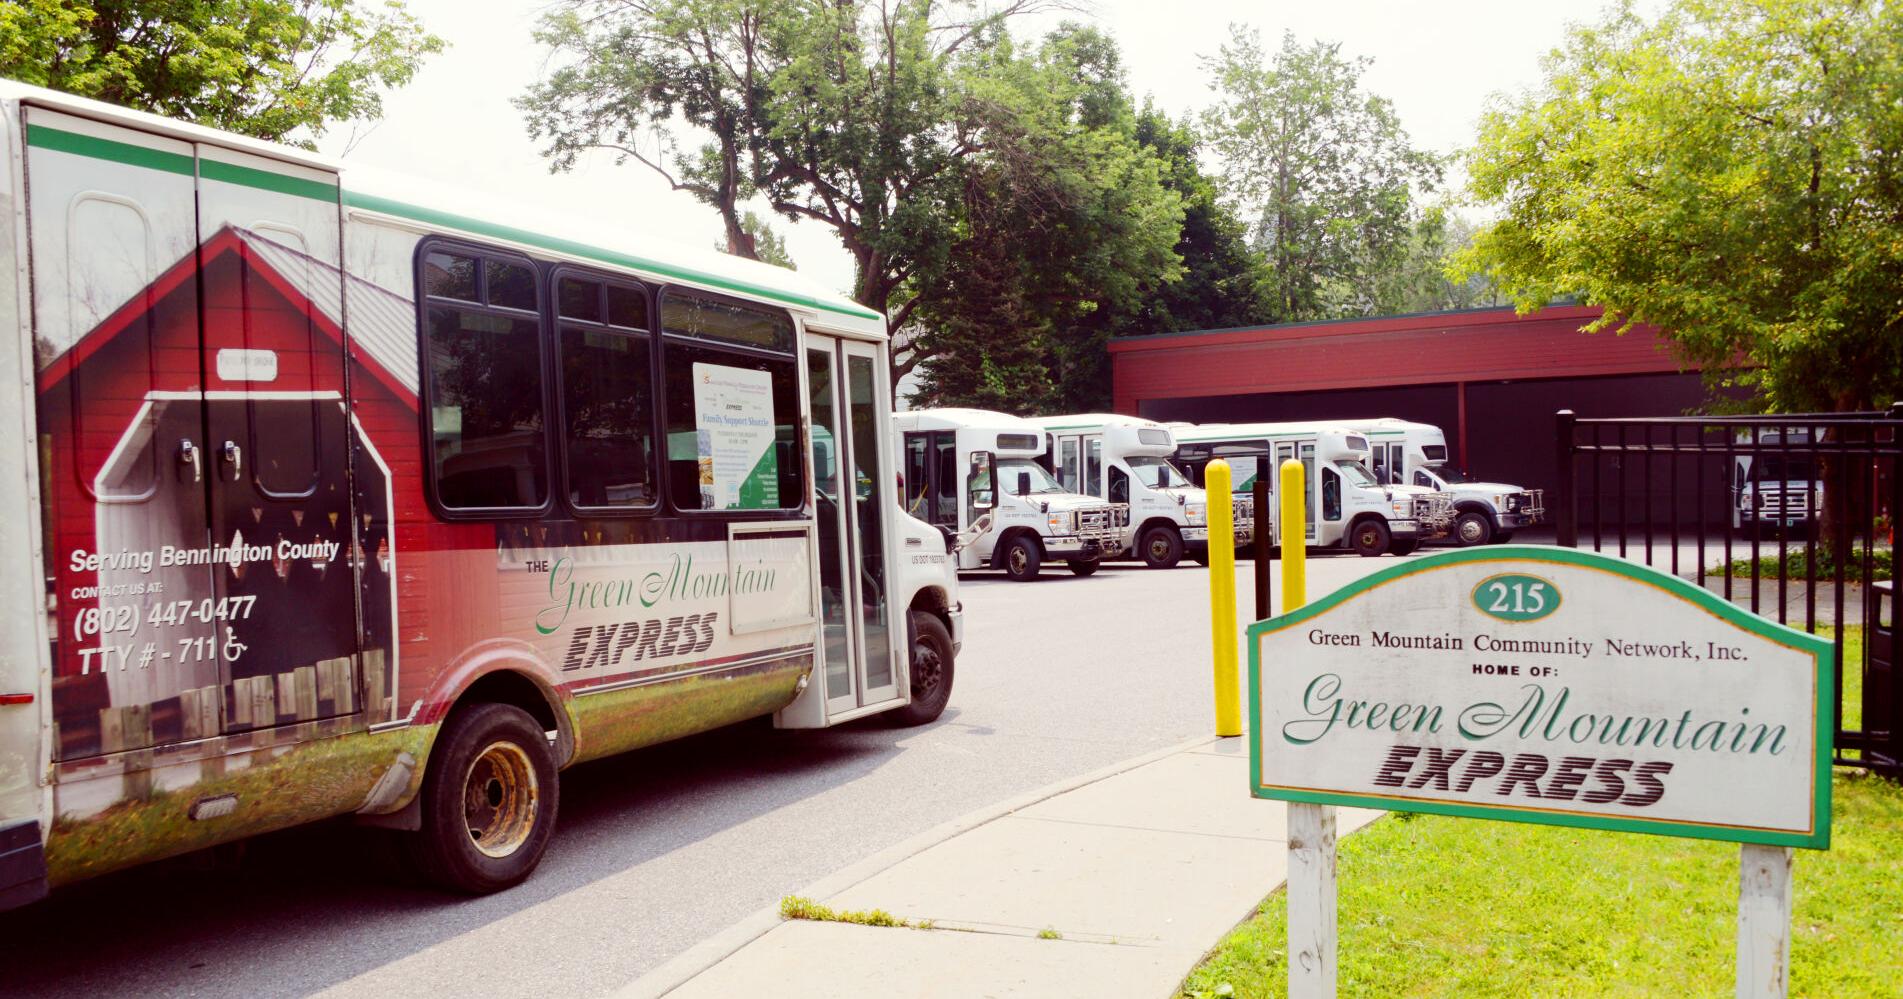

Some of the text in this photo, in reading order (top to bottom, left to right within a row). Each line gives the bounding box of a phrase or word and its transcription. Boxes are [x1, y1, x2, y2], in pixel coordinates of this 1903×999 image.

[69, 539, 340, 574] Serving Bennington County
[526, 560, 549, 573] THE
[71, 584, 126, 600] CONTACT
[128, 583, 145, 595] US
[536, 552, 776, 635] Green Mountain
[1488, 582, 1545, 614] 215
[74, 595, 257, 642] (802) 447-0477
[78, 645, 135, 675] TTY
[139, 642, 156, 669] #
[179, 637, 216, 663] 711
[561, 612, 718, 672] EXPRESS
[1308, 629, 1749, 662] Green Mountain Community Network, Inc.
[1472, 664, 1559, 678] HOME OF:
[1282, 672, 1786, 756] Green Mountain
[1373, 745, 1675, 806] EXPRESS
